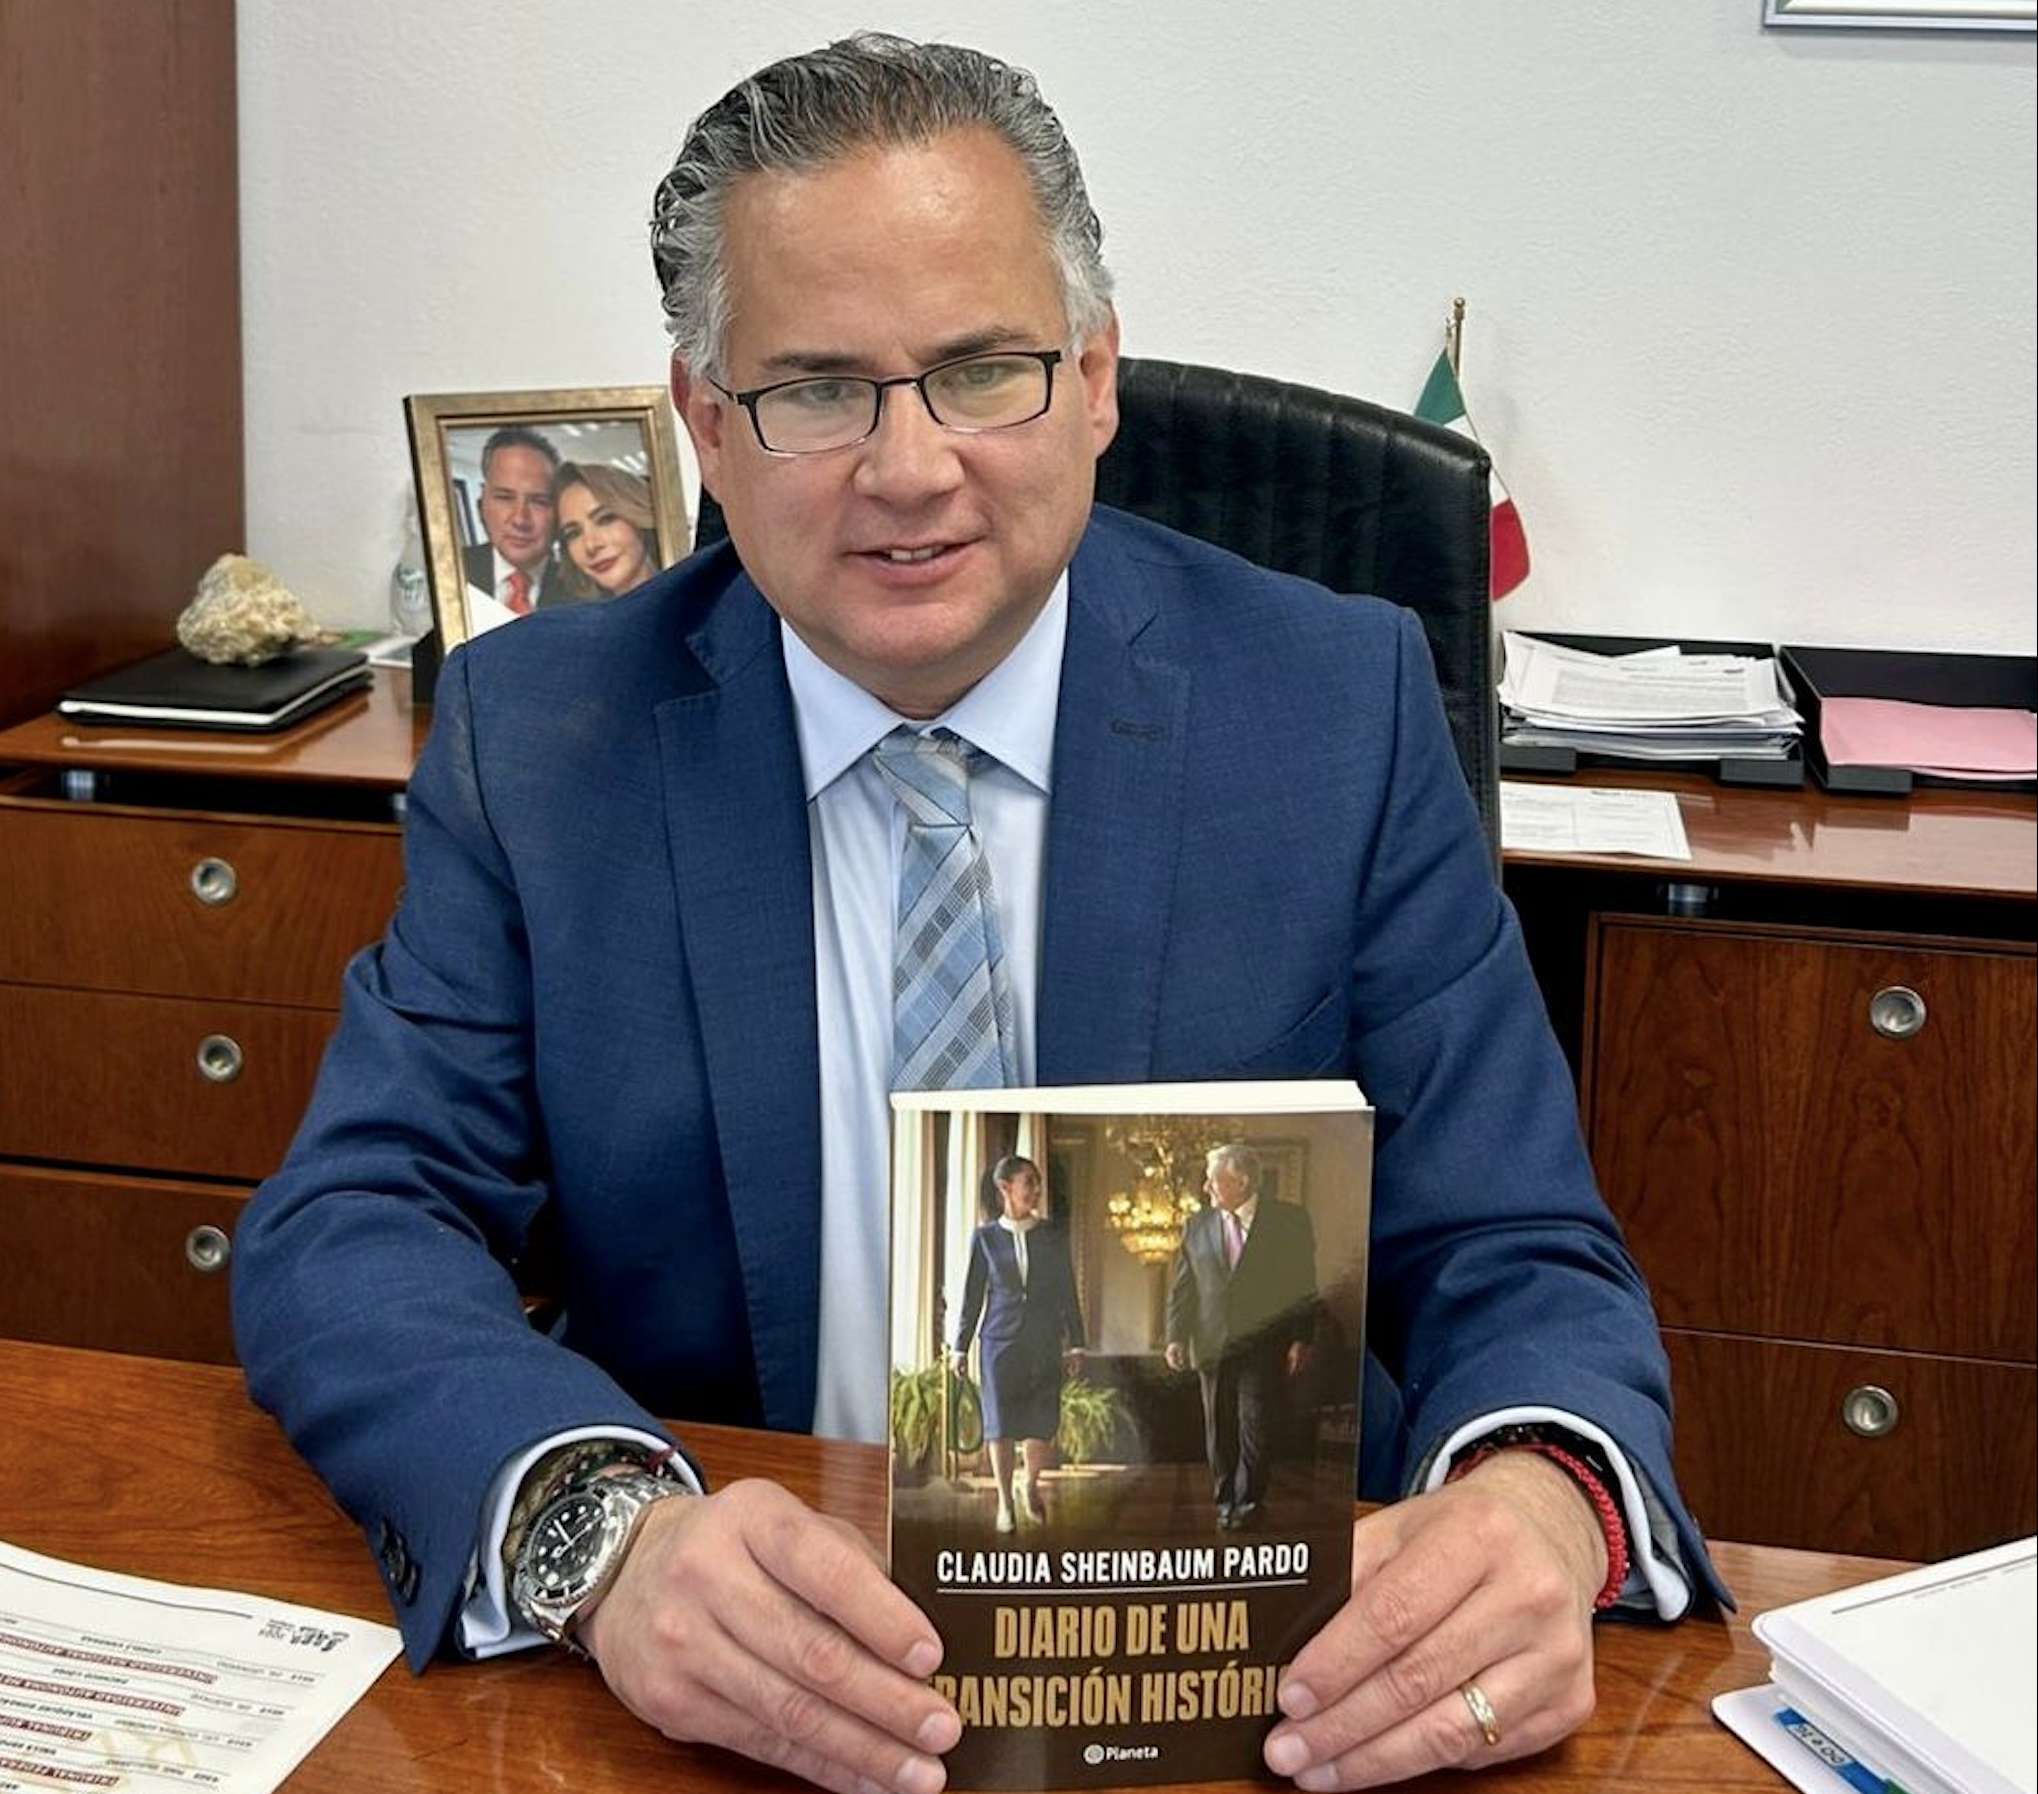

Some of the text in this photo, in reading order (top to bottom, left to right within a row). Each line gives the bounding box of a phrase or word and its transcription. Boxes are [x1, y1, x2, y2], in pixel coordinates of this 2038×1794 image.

[937, 1542, 1309, 1583] CLAUDIA SHEINBAUM PARDO
[994, 1600, 1250, 1658] DIARIO DE UNA
[929, 1660, 1291, 1728] RANSICIÓN HISTÓRI
[1106, 1746, 1159, 1760] Planeta
